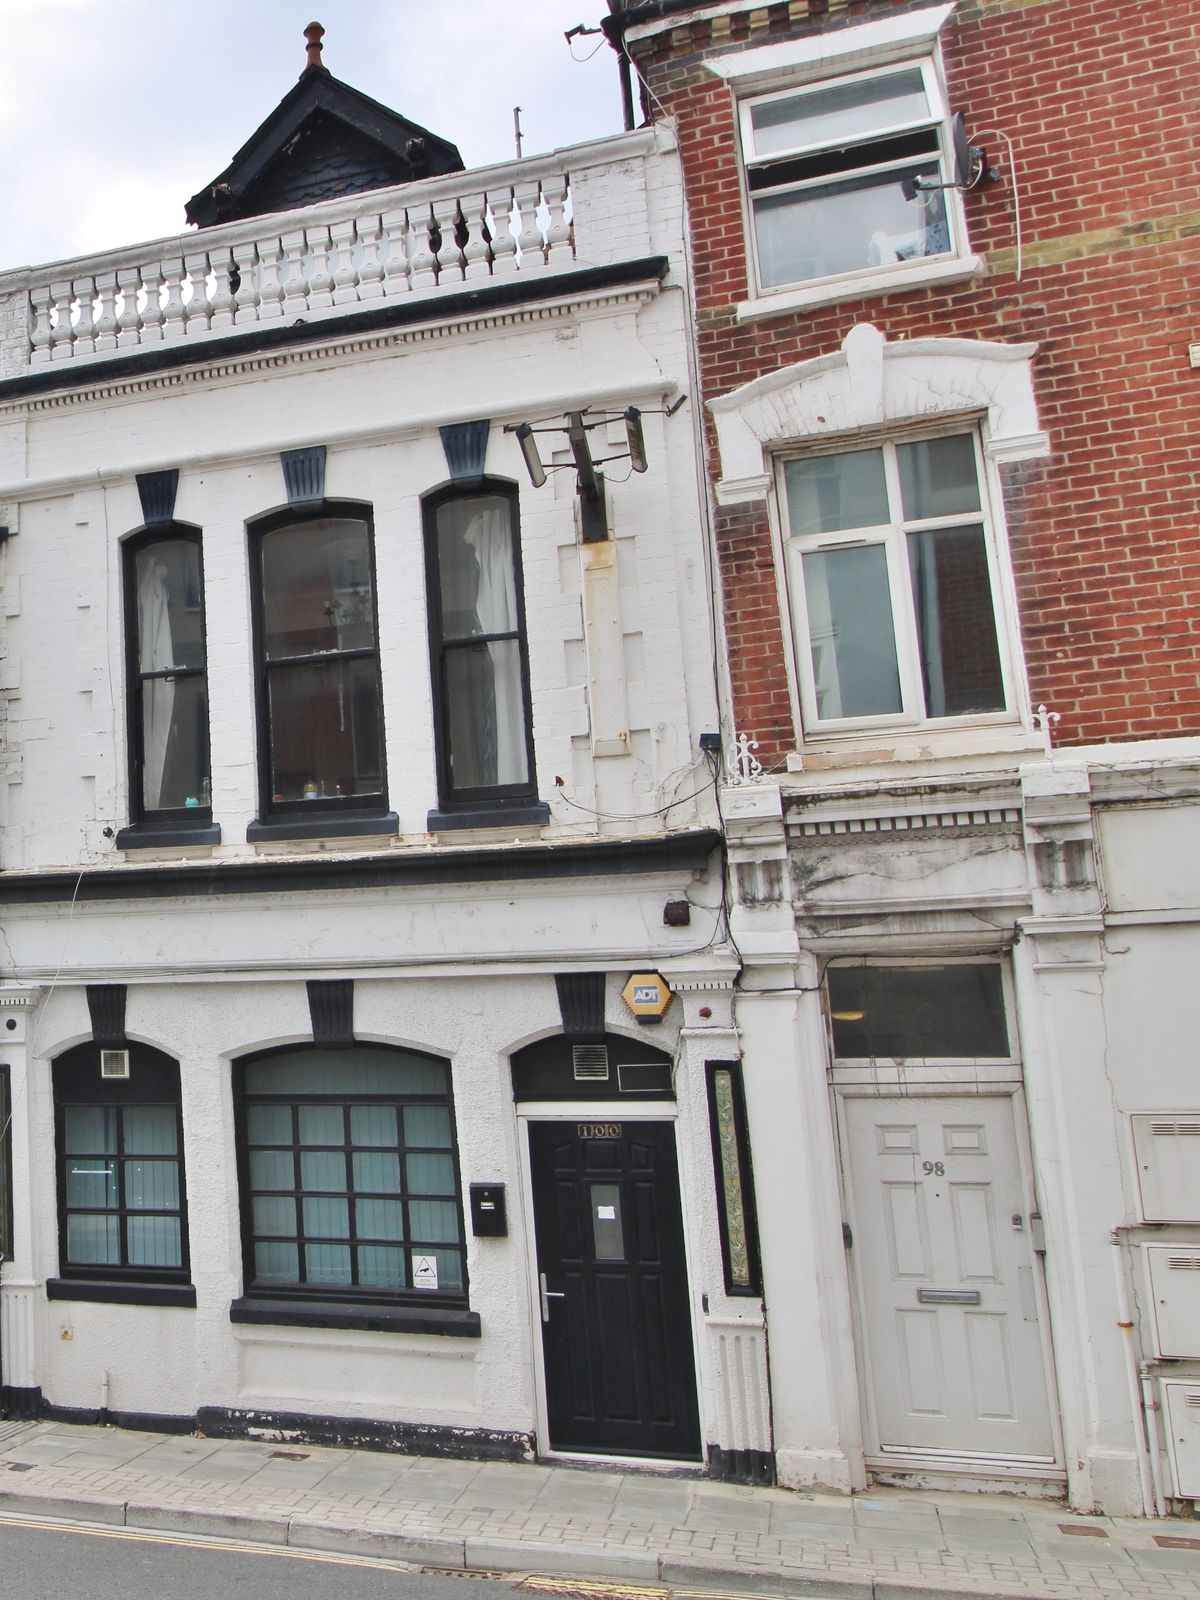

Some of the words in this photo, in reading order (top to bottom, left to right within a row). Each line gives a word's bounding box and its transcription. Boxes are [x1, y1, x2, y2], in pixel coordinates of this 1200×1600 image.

[634, 989, 658, 1000] ADT
[582, 1125, 619, 1137] 100
[922, 1160, 945, 1177] 98
